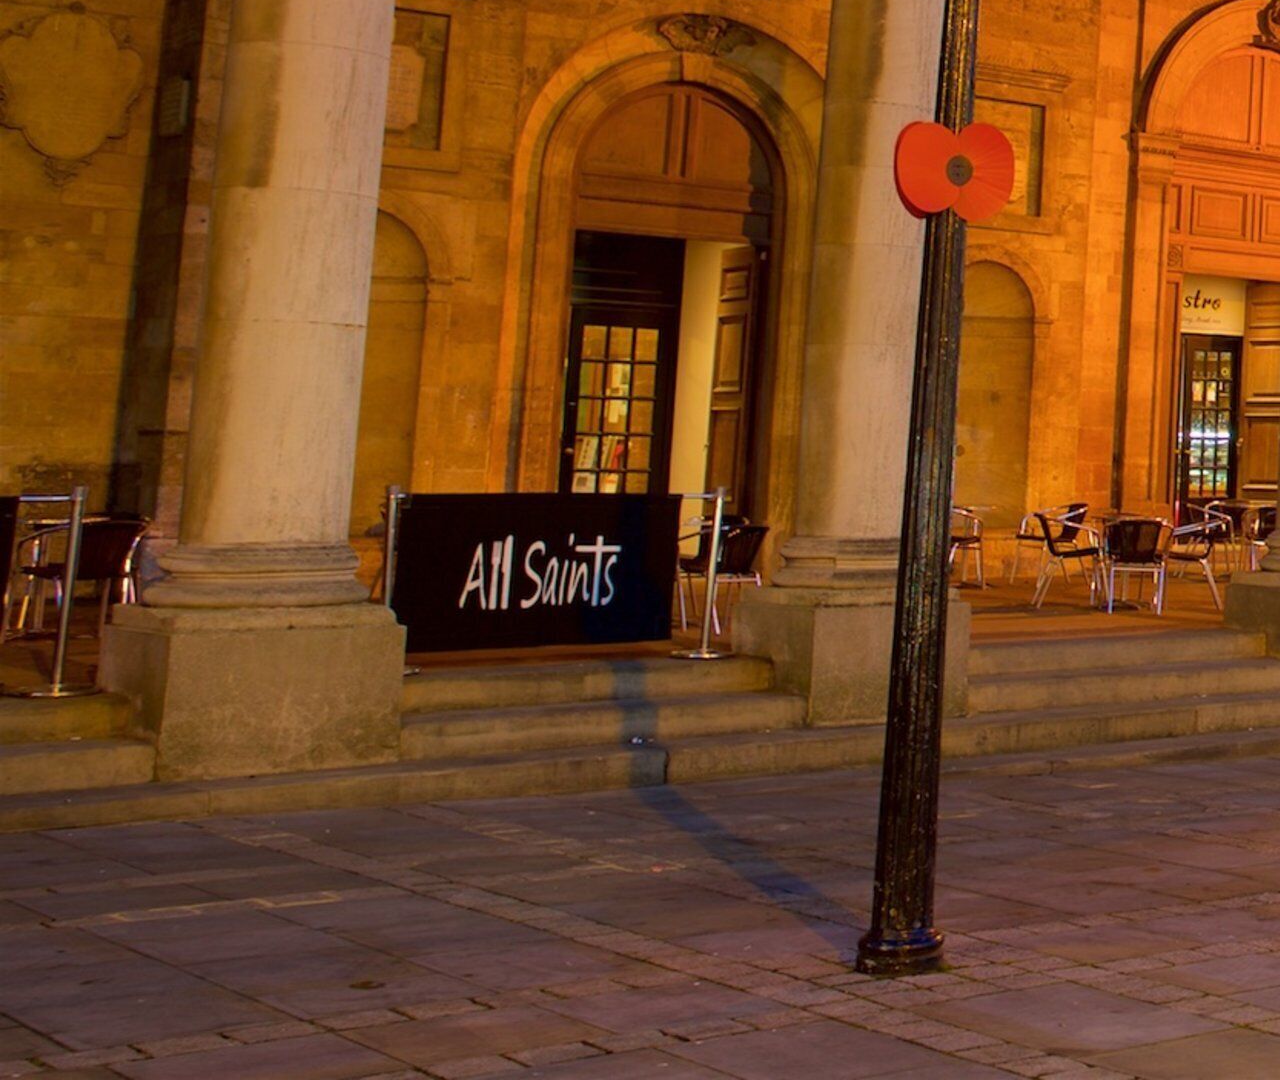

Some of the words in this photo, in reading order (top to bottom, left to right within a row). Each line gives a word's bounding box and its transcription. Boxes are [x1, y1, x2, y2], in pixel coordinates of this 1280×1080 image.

[1183, 289, 1222, 310] stro
[458, 534, 515, 611] All
[519, 532, 622, 610] Saints
